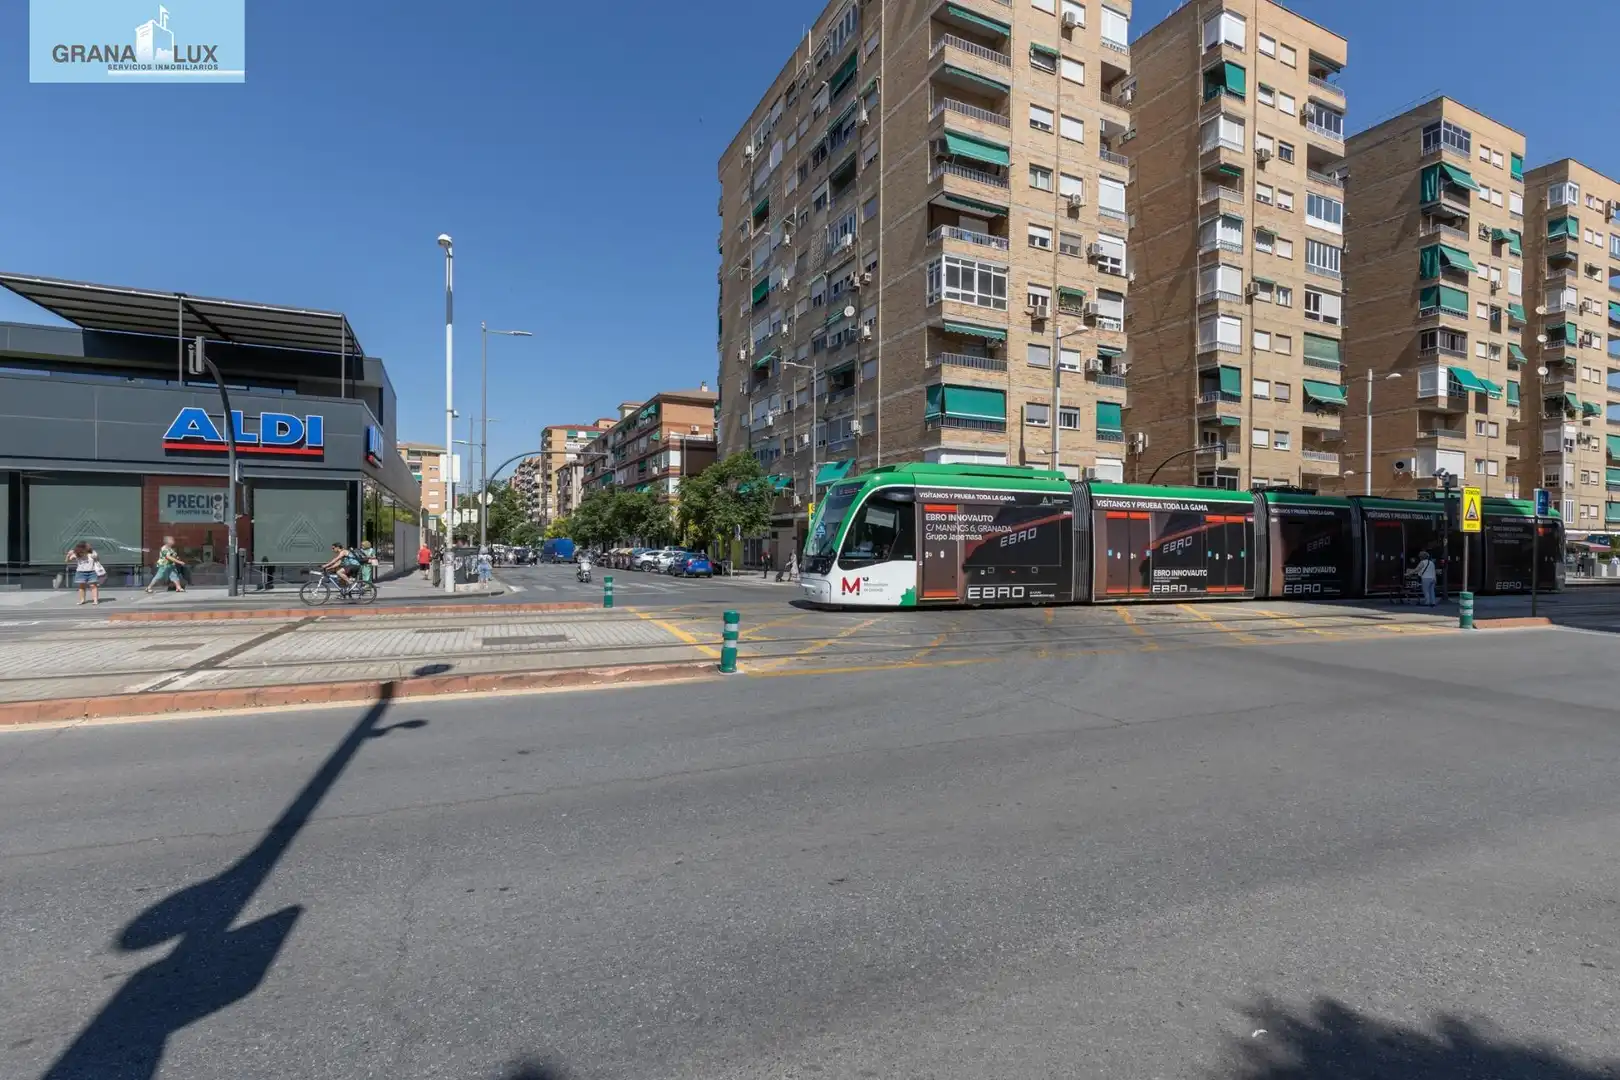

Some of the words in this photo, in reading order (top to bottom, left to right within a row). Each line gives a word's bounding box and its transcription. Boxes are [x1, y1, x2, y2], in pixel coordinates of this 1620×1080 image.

[163, 407, 324, 447] ALDI
[167, 493, 229, 509] PRECIS
[919, 491, 949, 500] VISÍTANOS
[953, 493, 976, 501] PRUEBA
[1096, 499, 1131, 509] VISÍTANOS
[1136, 502, 1162, 510] PRUEBA
[1190, 504, 1208, 512] GAMA
[948, 514, 994, 522] INNOVAUTO
[926, 524, 935, 532] C/
[977, 525, 1013, 533] GRANADA
[925, 532, 947, 541] Grupo
[1000, 527, 1037, 547] EBRO
[1162, 535, 1193, 554] EBRO
[1153, 569, 1171, 577] EBRO
[1171, 569, 1208, 577] INNOVAUTO
[1285, 566, 1302, 574] EBRO
[1302, 566, 1337, 574] INNOVAUTO
[967, 586, 1025, 599] EBRO
[1152, 584, 1188, 593] EBRO
[1283, 583, 1321, 594] EBRO
